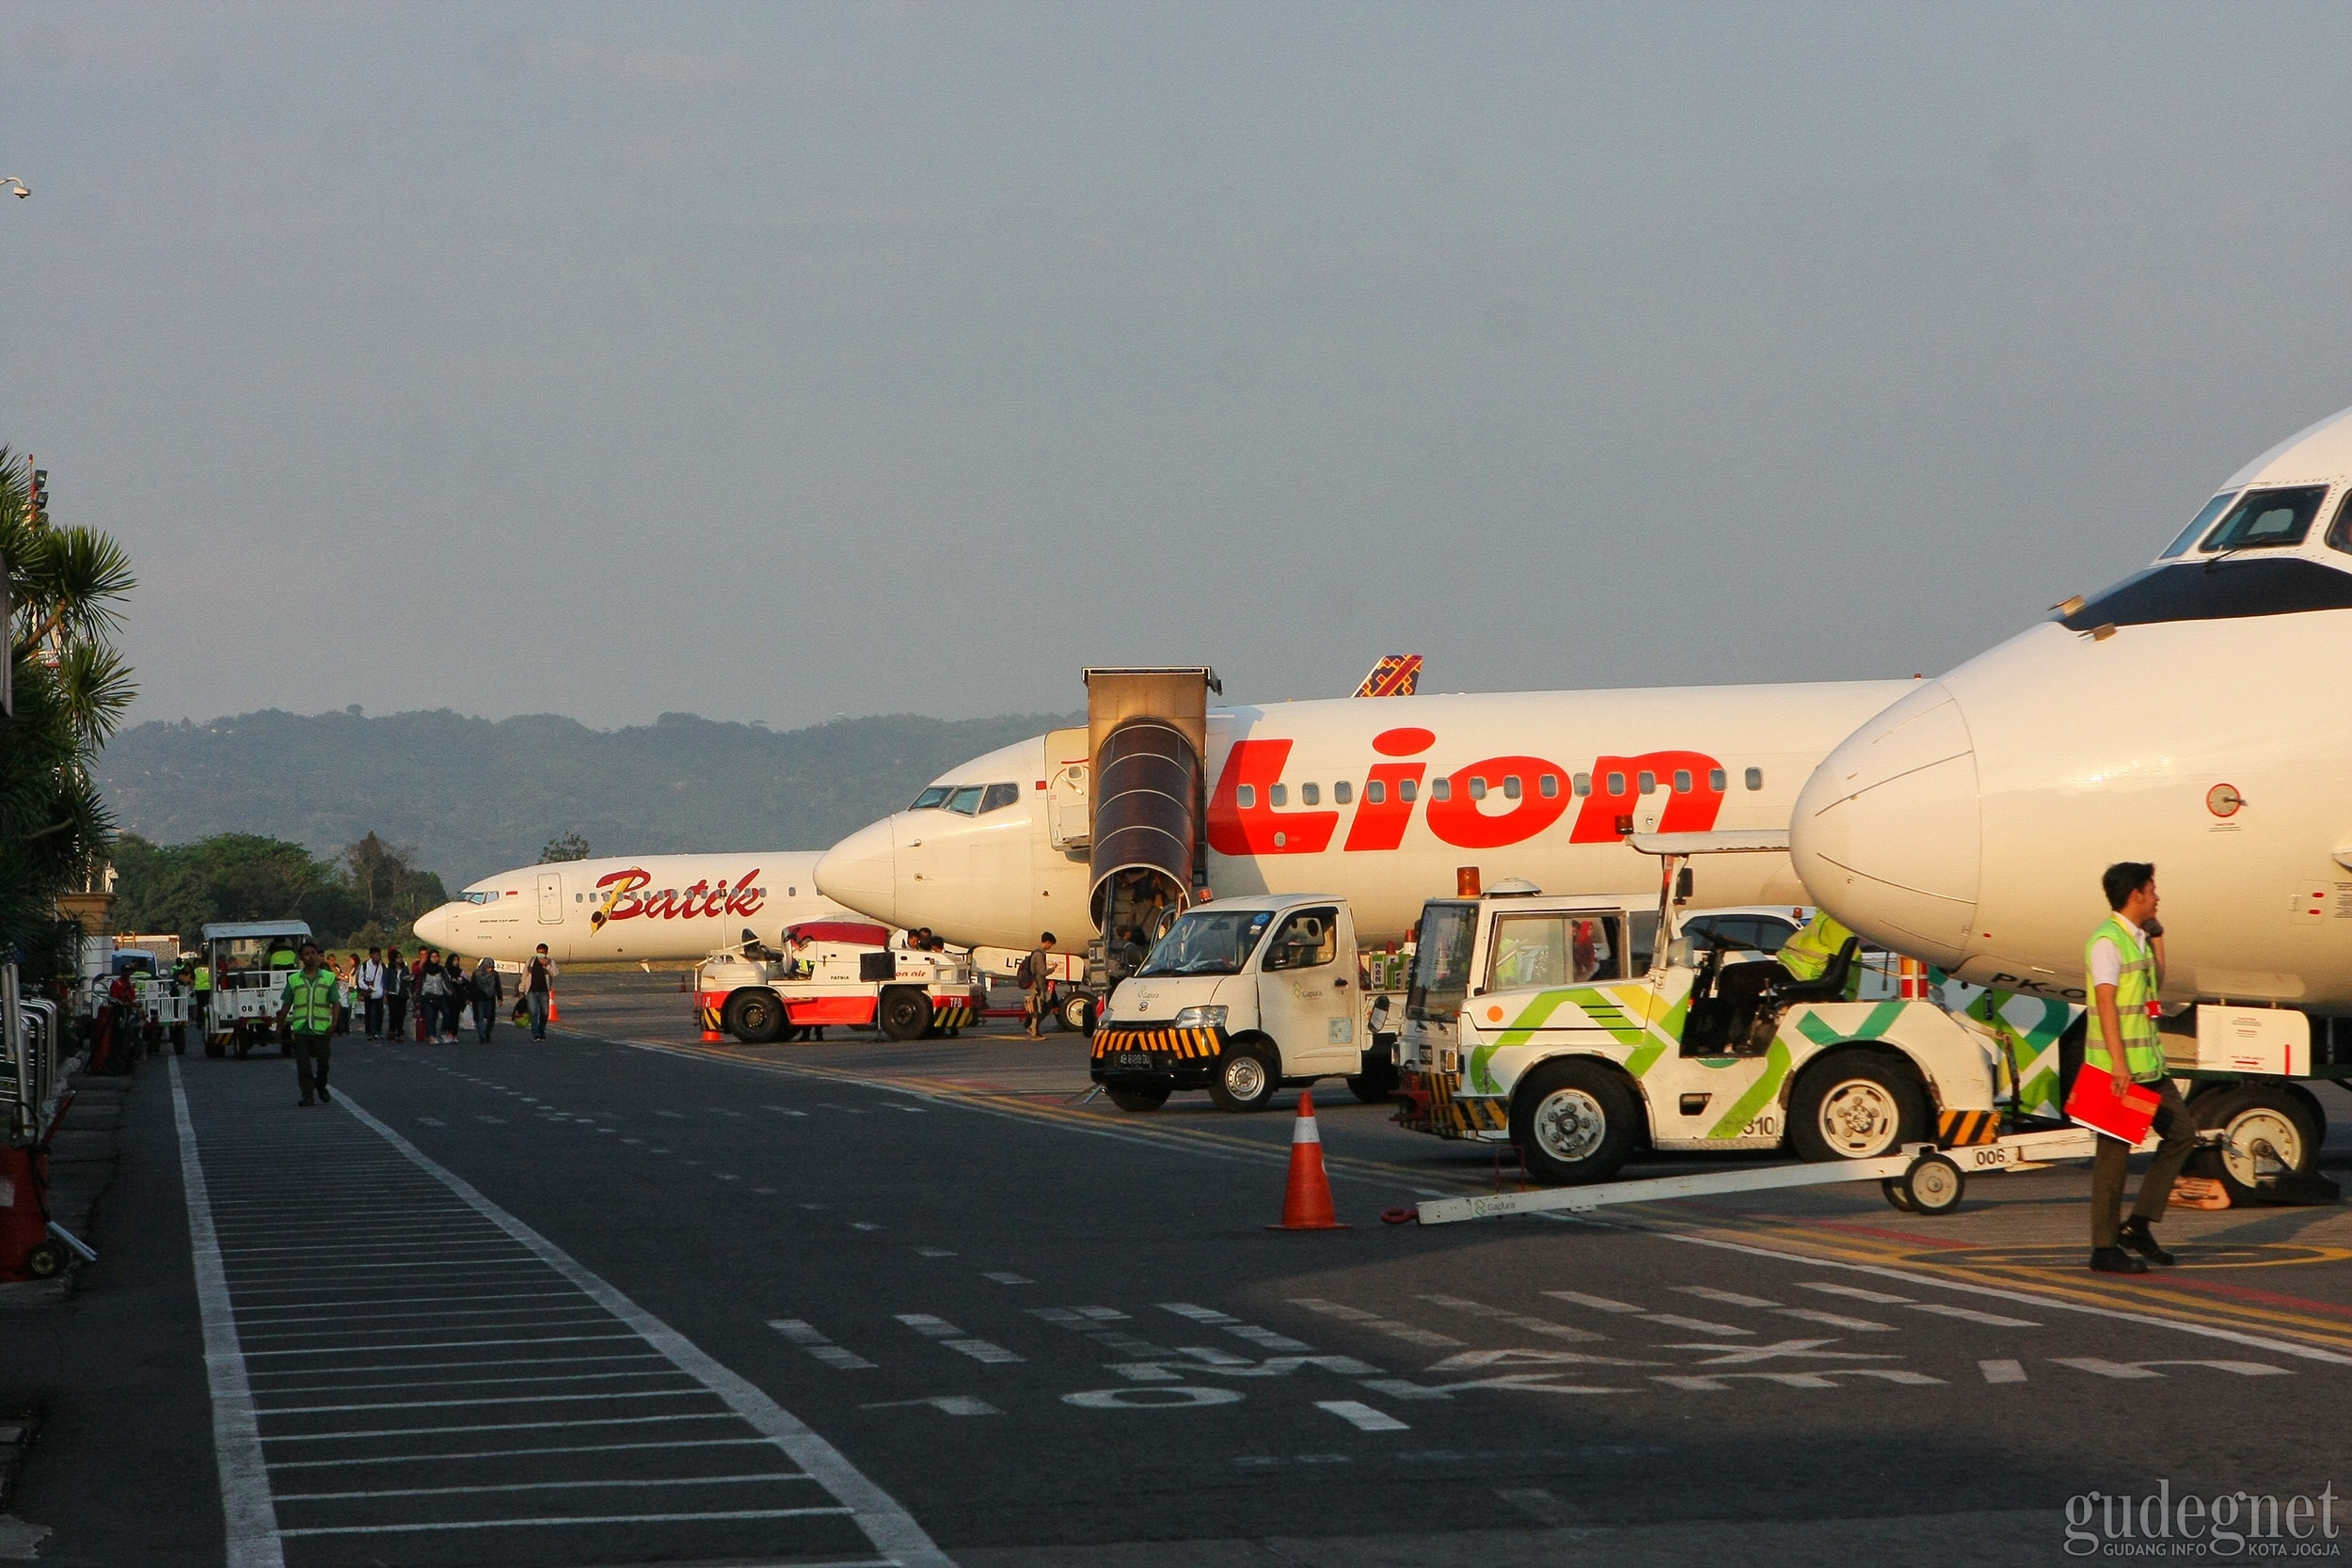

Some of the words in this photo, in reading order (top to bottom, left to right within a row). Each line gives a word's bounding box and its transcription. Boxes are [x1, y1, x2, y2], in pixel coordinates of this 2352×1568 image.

[1207, 728, 1726, 854] Lion
[596, 866, 765, 921] Batik
[1977, 1148, 2006, 1165] 006
[1486, 1200, 1517, 1212] Gapura
